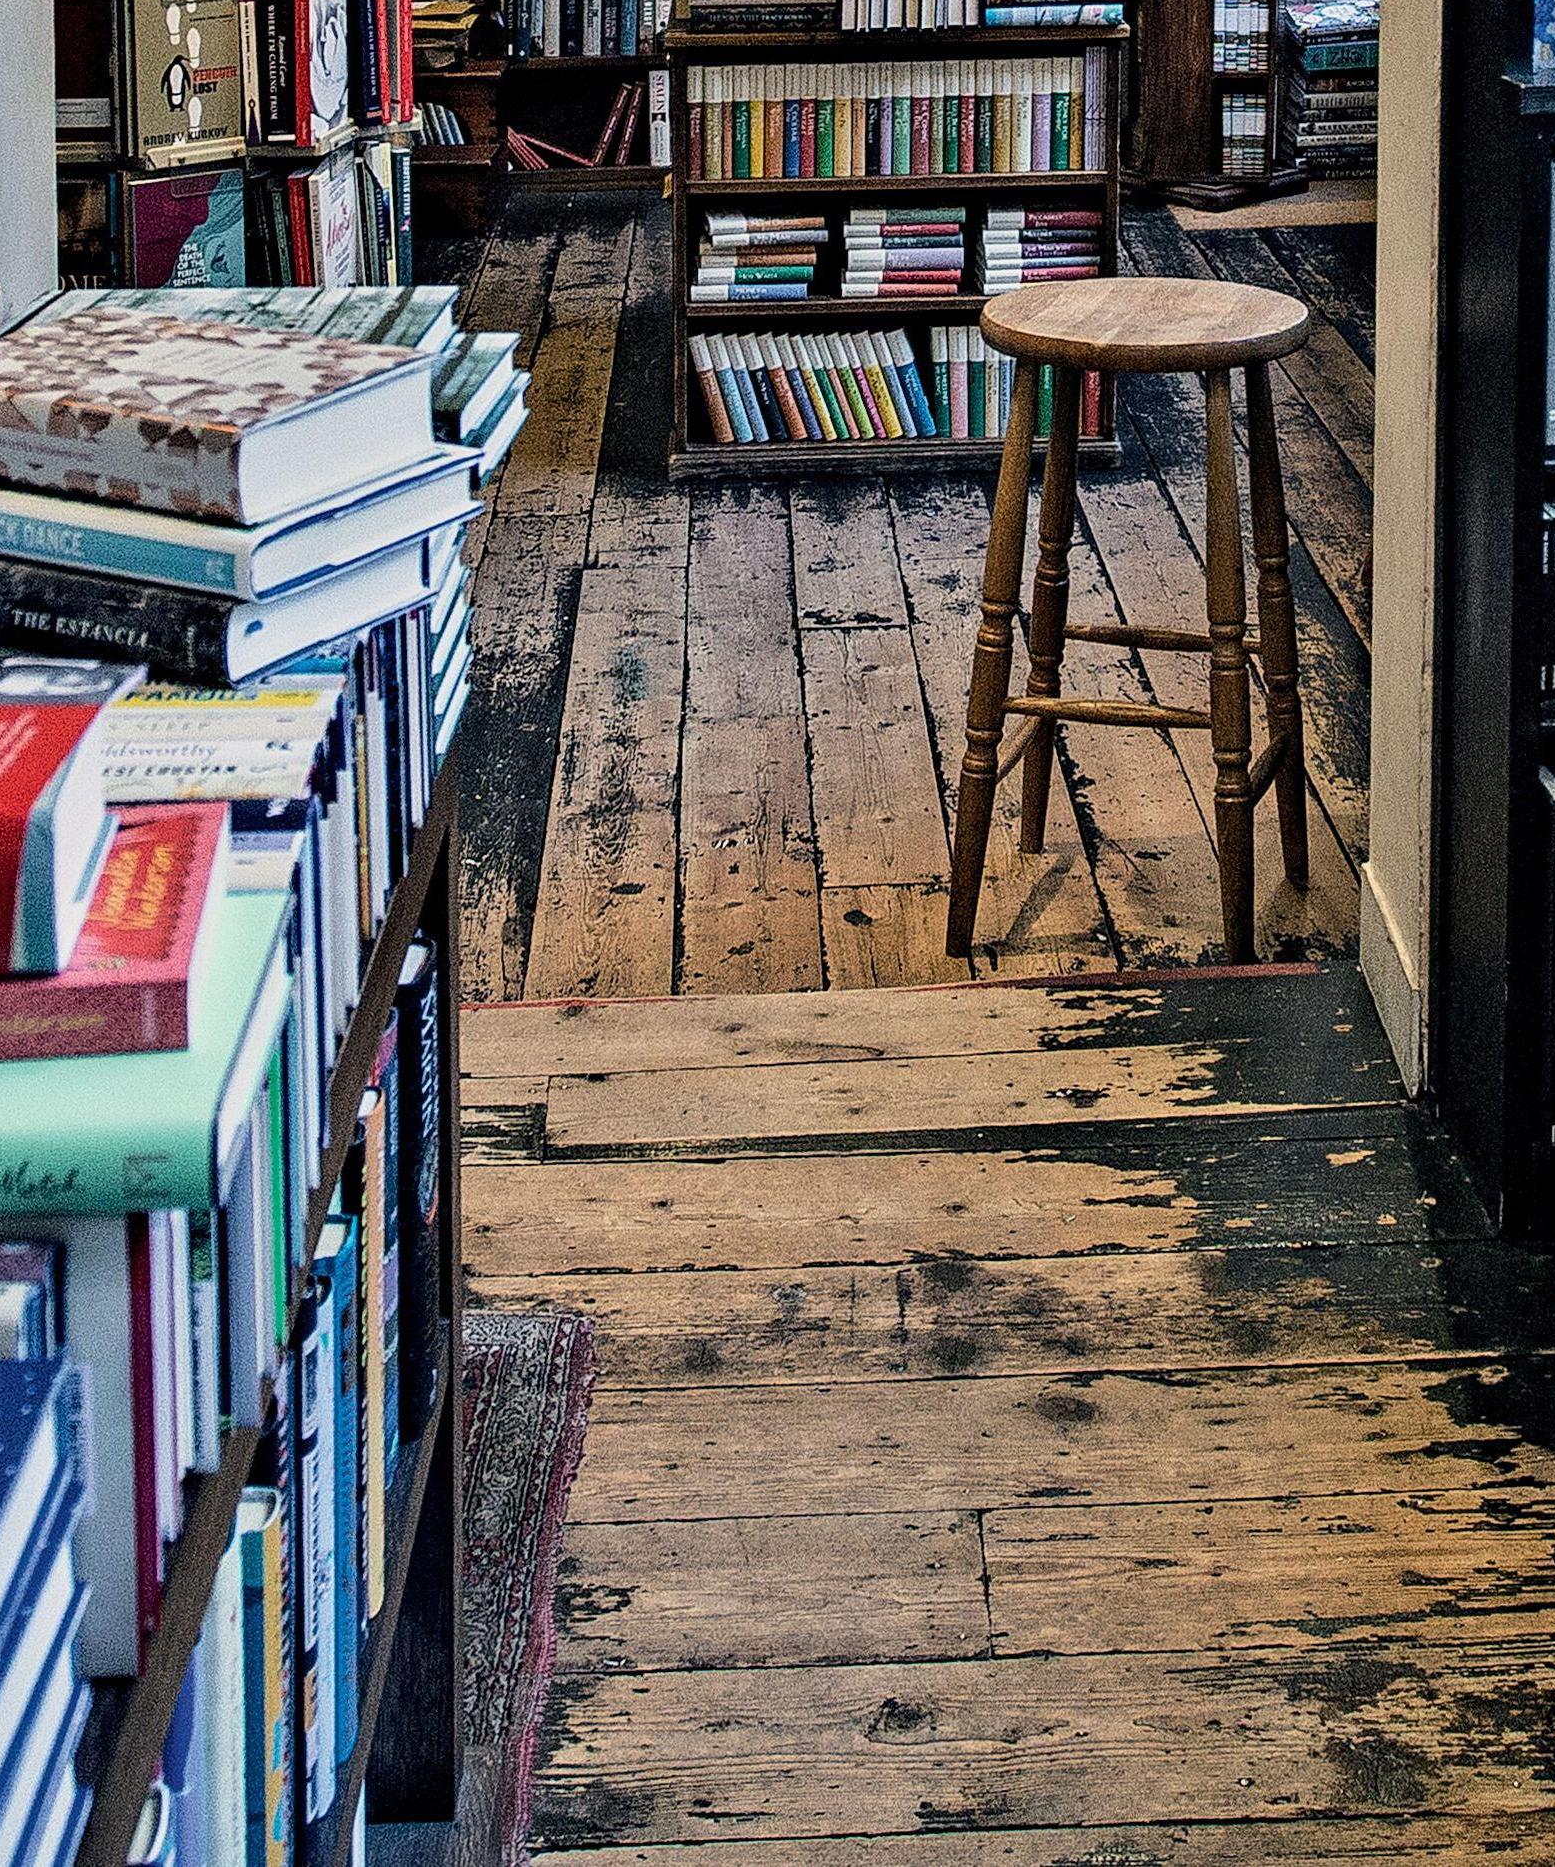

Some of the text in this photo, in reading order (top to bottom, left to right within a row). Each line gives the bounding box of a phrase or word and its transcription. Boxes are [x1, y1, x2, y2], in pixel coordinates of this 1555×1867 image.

[181, 243, 197, 252] THE
[176, 258, 205, 269] OF THE
